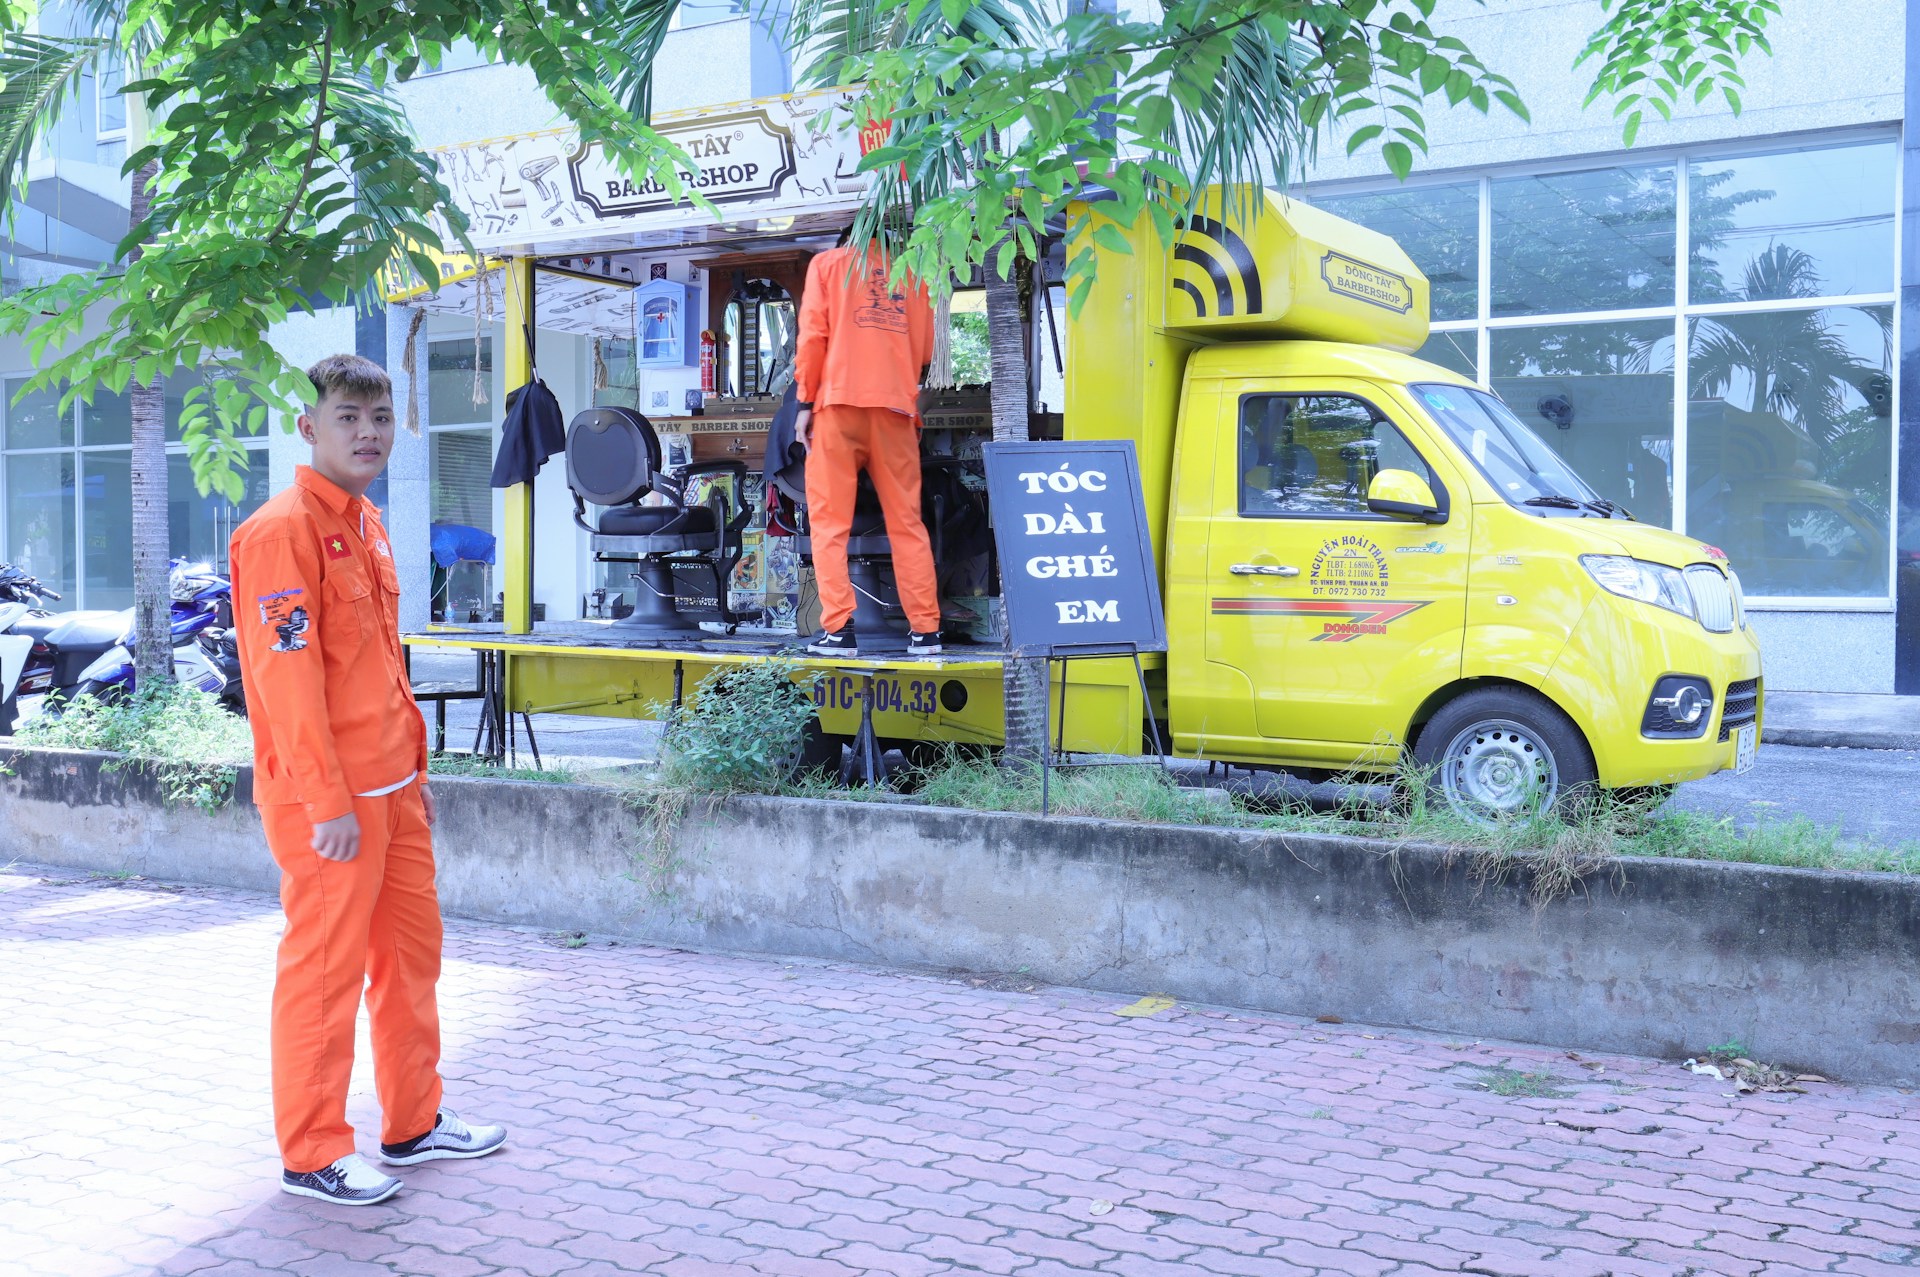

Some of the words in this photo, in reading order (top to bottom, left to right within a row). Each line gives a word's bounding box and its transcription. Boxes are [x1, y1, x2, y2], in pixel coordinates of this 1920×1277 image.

[606, 163, 759, 198] BARBRSHOP
[1337, 275, 1400, 304] BARBERSHOP
[658, 422, 682, 433] TÂY
[692, 421, 739, 432] BARBER
[948, 416, 984, 426] SHOP
[1018, 462, 1107, 494] TÓC
[1023, 502, 1106, 535] DÀI
[1025, 545, 1118, 579] GHÉ
[1326, 560, 1347, 569] TLBT:
[1326, 569, 1346, 577] TLTB:
[1368, 543, 1389, 579] THANH
[1328, 587, 1349, 596] 0972
[1352, 588, 1368, 596] 730
[1370, 588, 1386, 597] 732
[1055, 600, 1121, 624] EM
[1324, 623, 1387, 634] DONGBEN
